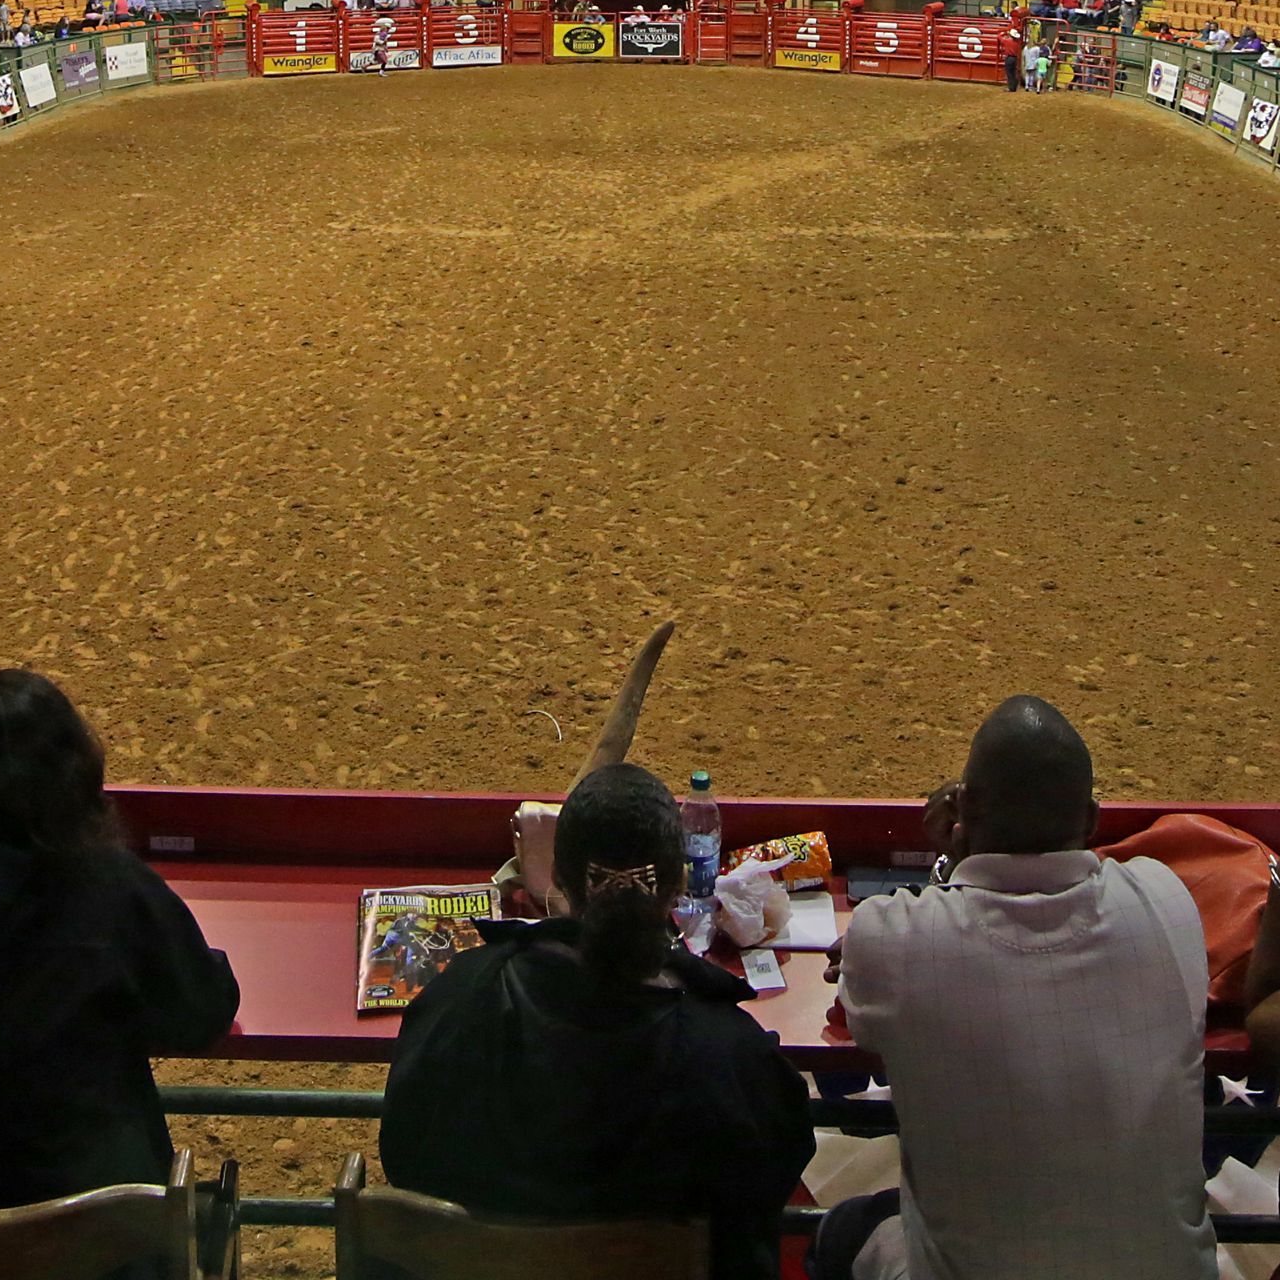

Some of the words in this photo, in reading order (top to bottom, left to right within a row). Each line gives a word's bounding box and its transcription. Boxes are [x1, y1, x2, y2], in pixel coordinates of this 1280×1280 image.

[289, 21, 306, 52] 1
[454, 14, 479, 44] 3
[622, 33, 678, 42] STOCKYARDS
[796, 17, 821, 48] 4
[873, 22, 900, 53] 5
[957, 27, 984, 59] 6
[271, 55, 330, 71] Wrangler
[435, 51, 465, 61] Aflac
[468, 50, 497, 60] Aflac
[783, 50, 833, 67] Wrangler
[365, 894, 425, 907] STOCKYARDS
[426, 894, 490, 916] RODEO
[364, 999, 377, 1008] THE
[378, 998, 410, 1008] WORLD'S
